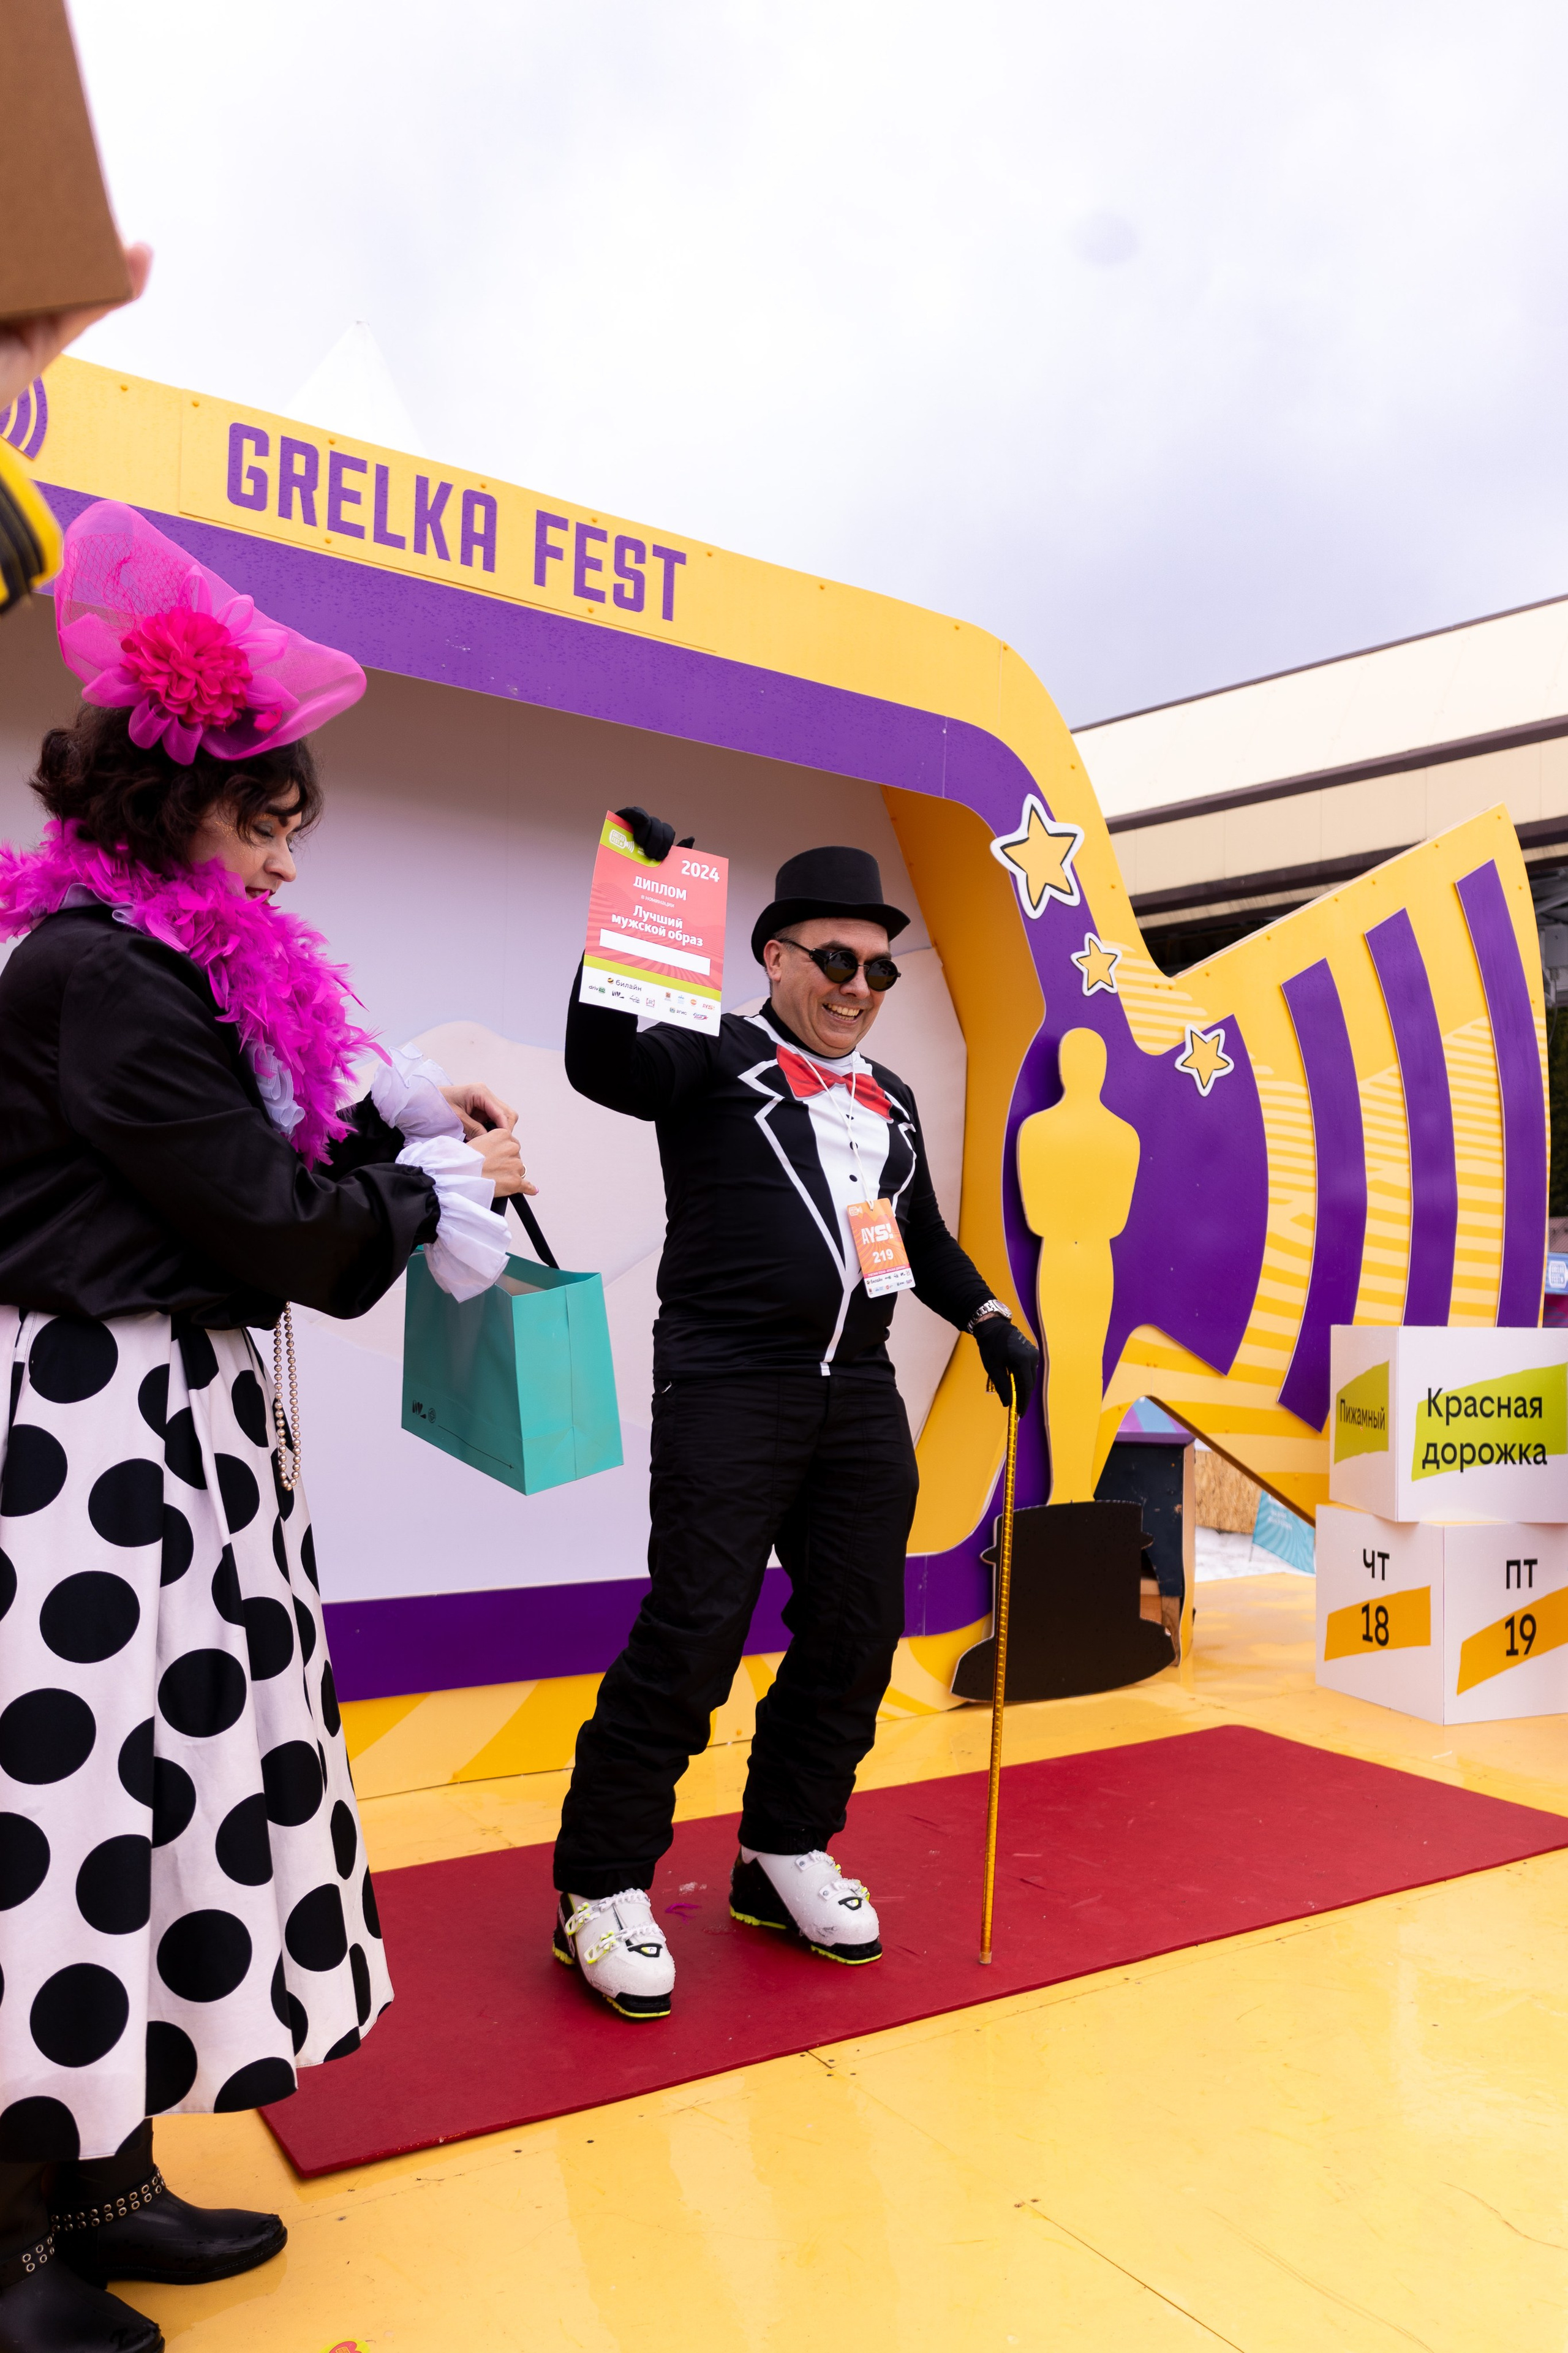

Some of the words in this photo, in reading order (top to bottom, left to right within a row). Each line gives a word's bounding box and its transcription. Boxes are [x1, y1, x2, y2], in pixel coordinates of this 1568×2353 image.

[227, 421, 497, 573] GRELKA
[533, 508, 687, 622] FEST
[681, 859, 720, 883] 2024
[633, 875, 687, 901] ДИПЛОМ
[645, 896, 675, 908] номинации
[611, 913, 666, 937] мужской
[668, 929, 704, 946] образ
[633, 905, 683, 929] Лучший
[616, 980, 642, 992] билайн
[861, 1223, 894, 1245] AYS!
[872, 1248, 894, 1264] 219
[1340, 1399, 1385, 1431] Пижамный
[1427, 1388, 1543, 1426] Красная
[1422, 1442, 1548, 1473] дорожка
[1362, 1602, 1390, 1647] 18
[1505, 1613, 1537, 1656] 19
